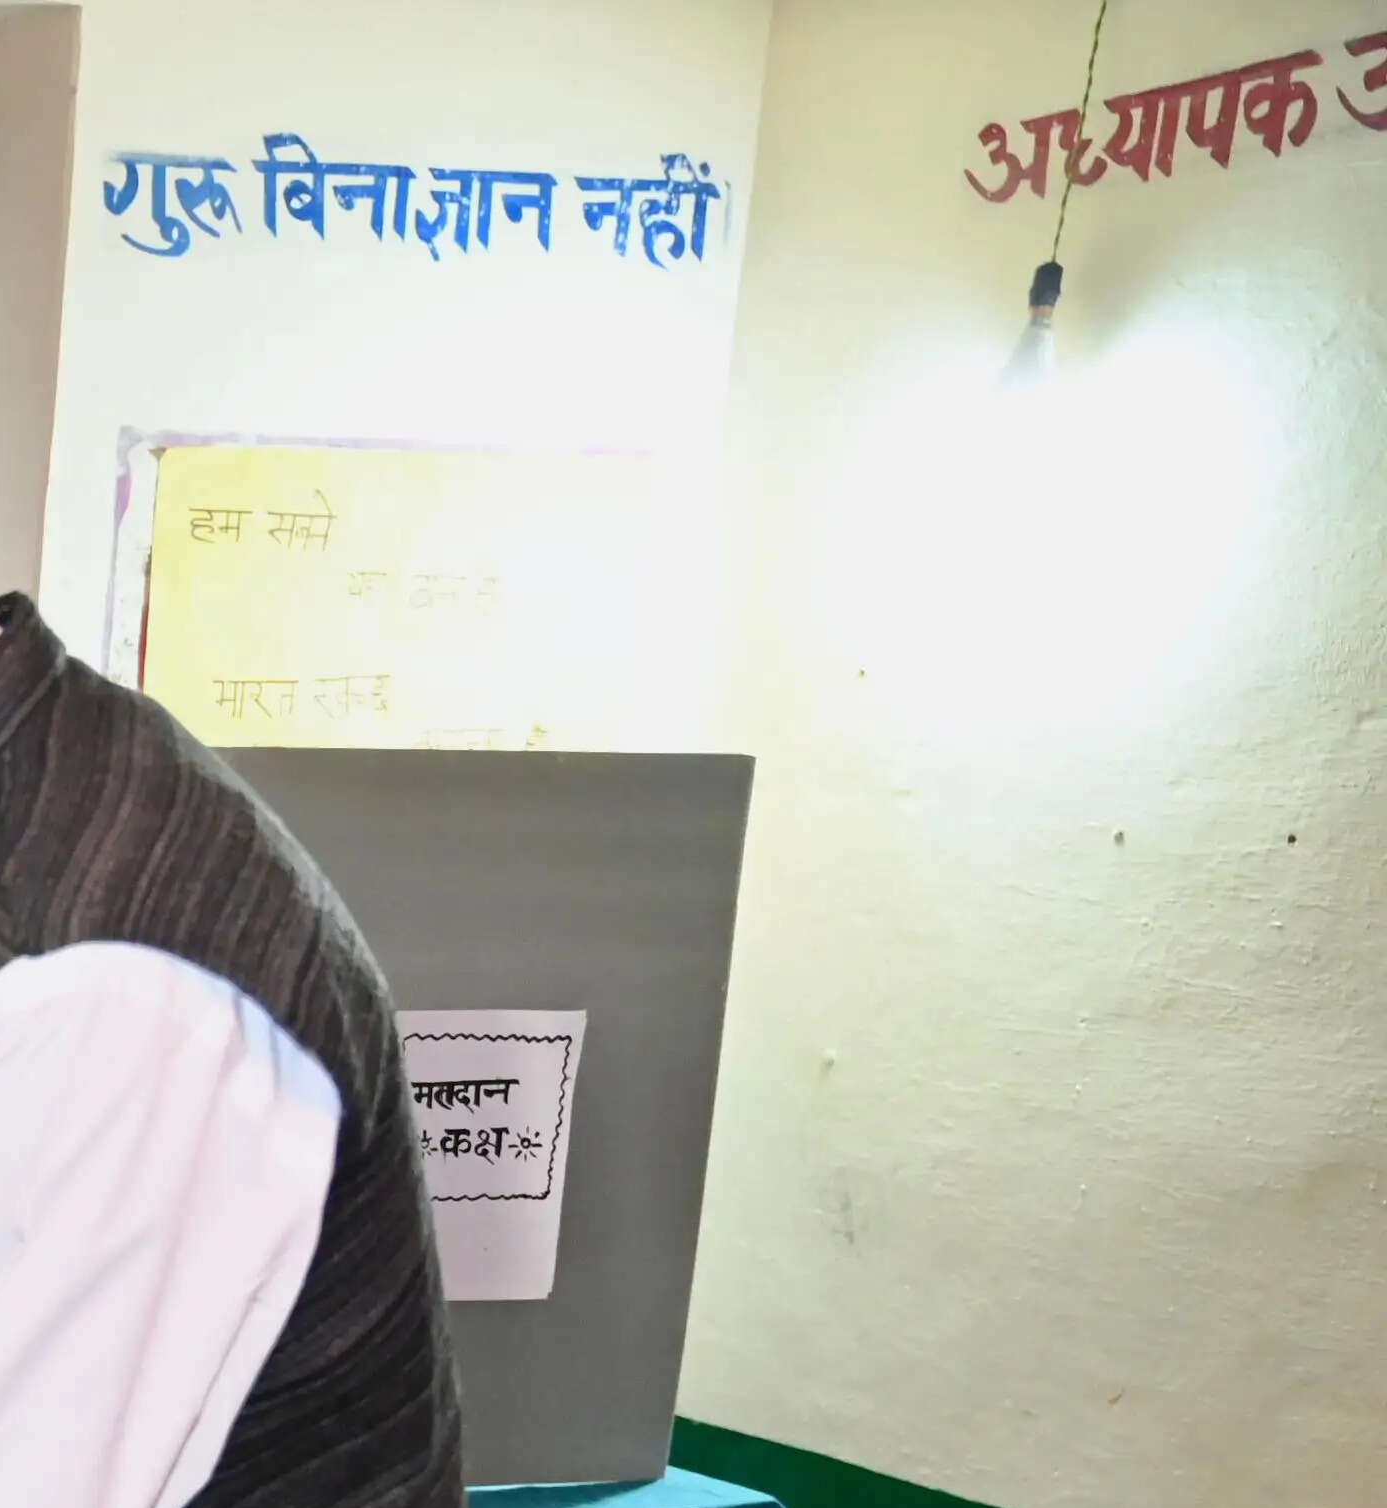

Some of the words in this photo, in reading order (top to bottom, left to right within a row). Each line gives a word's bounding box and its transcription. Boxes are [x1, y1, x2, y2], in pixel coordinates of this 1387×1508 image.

[963, 49, 1324, 203] अध्यापक
[250, 132, 417, 243] बिना
[414, 166, 559, 262] ज्ञान
[188, 507, 254, 545] हम
[212, 679, 300, 720] भारत
[440, 1127, 511, 1166] कक्ष
